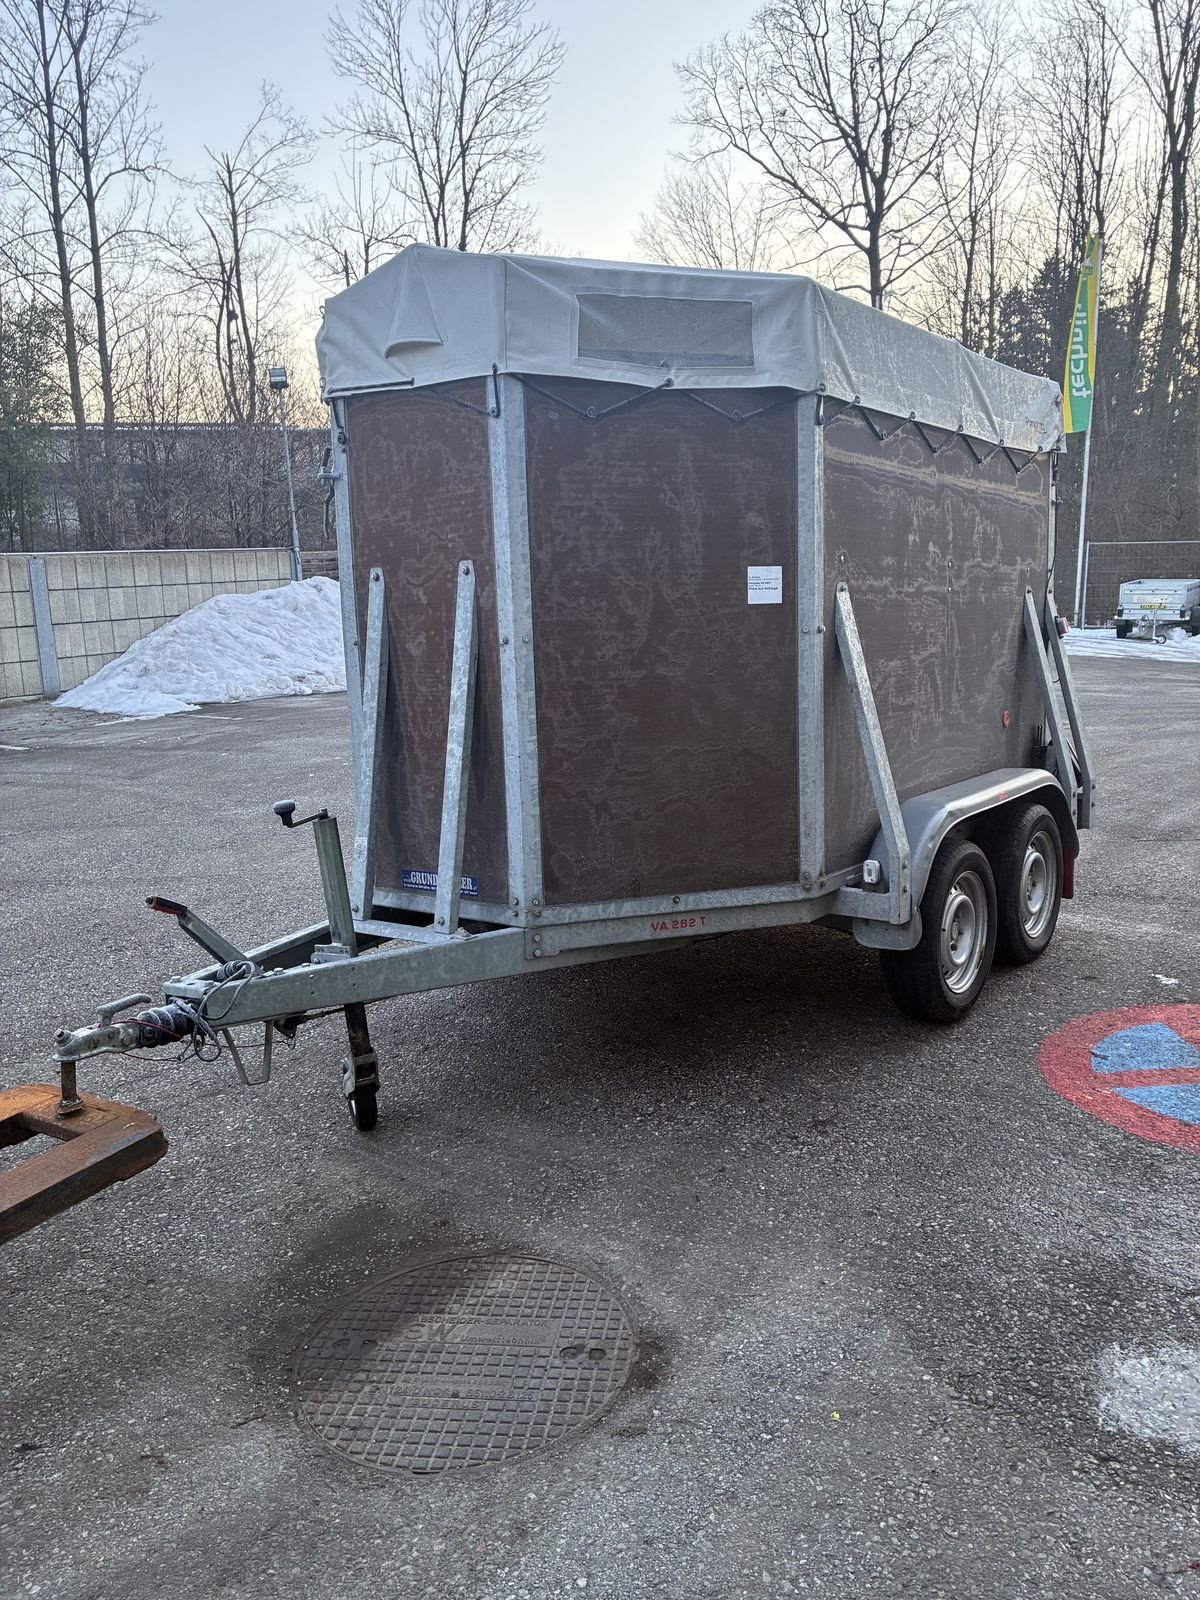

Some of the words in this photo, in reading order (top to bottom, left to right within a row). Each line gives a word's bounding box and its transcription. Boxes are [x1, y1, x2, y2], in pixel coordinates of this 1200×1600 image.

[650, 920, 669, 931] VA
[671, 917, 696, 929] 282
[699, 916, 706, 926] T
